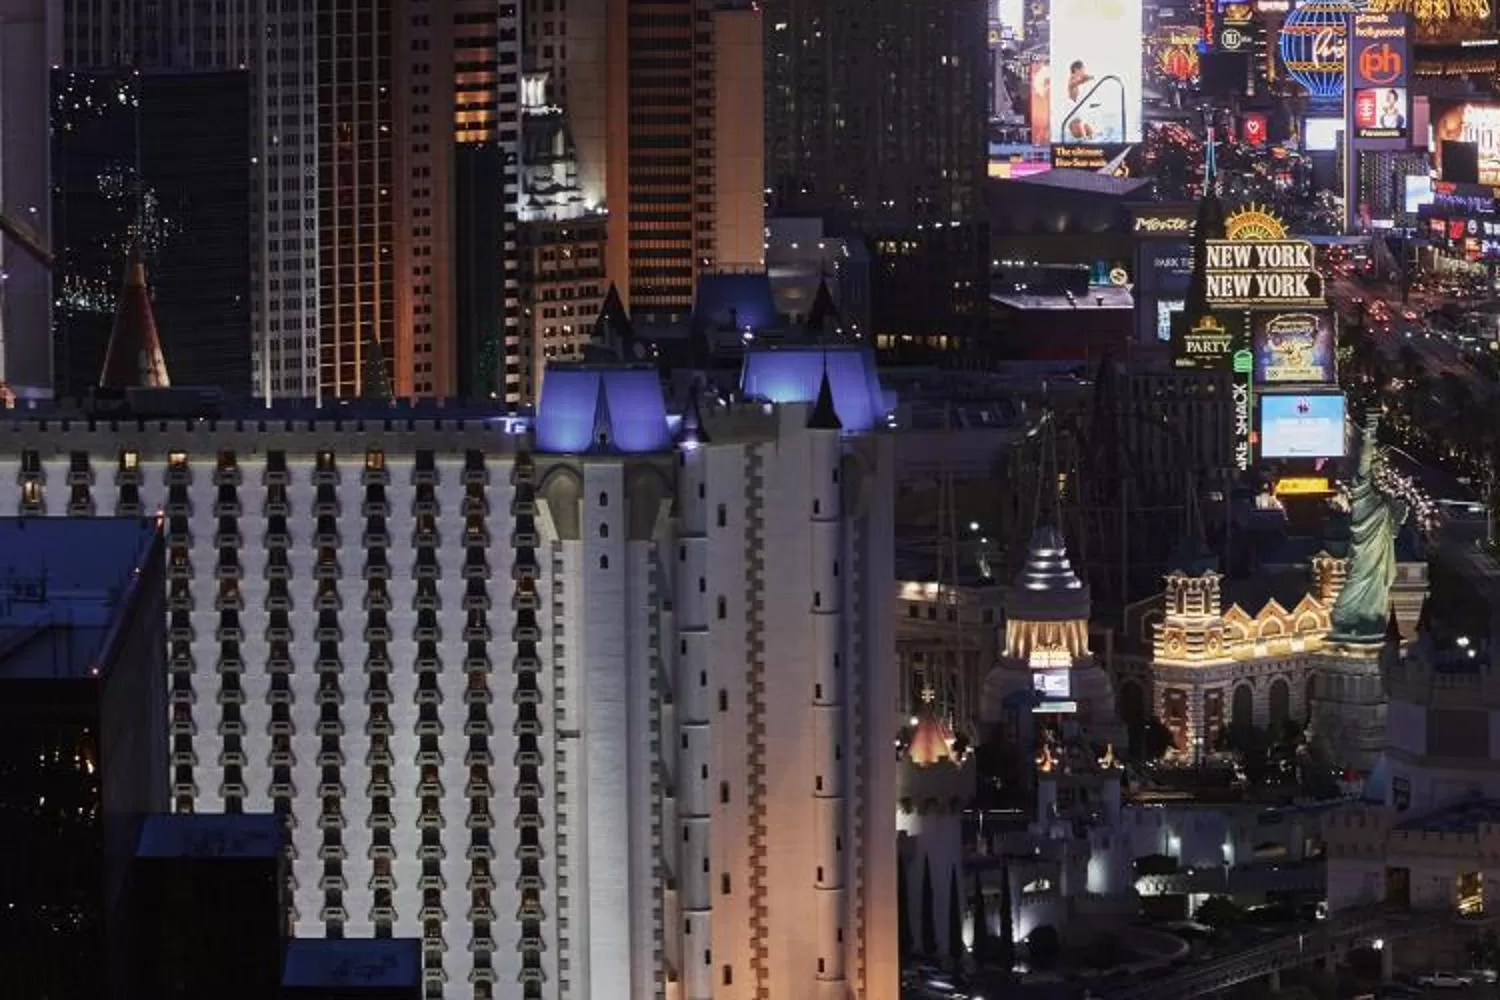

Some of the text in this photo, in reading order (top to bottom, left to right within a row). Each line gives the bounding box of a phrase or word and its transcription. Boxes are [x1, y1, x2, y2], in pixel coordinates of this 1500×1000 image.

[1355, 14, 1390, 25] planet
[1355, 26, 1406, 39] hollywood
[1362, 43, 1402, 80] ph
[1206, 245, 1253, 268] NEW
[1255, 245, 1311, 268] YORK
[1206, 274, 1311, 298] NEW YORK
[1232, 383, 1248, 471] AKE SHACK
